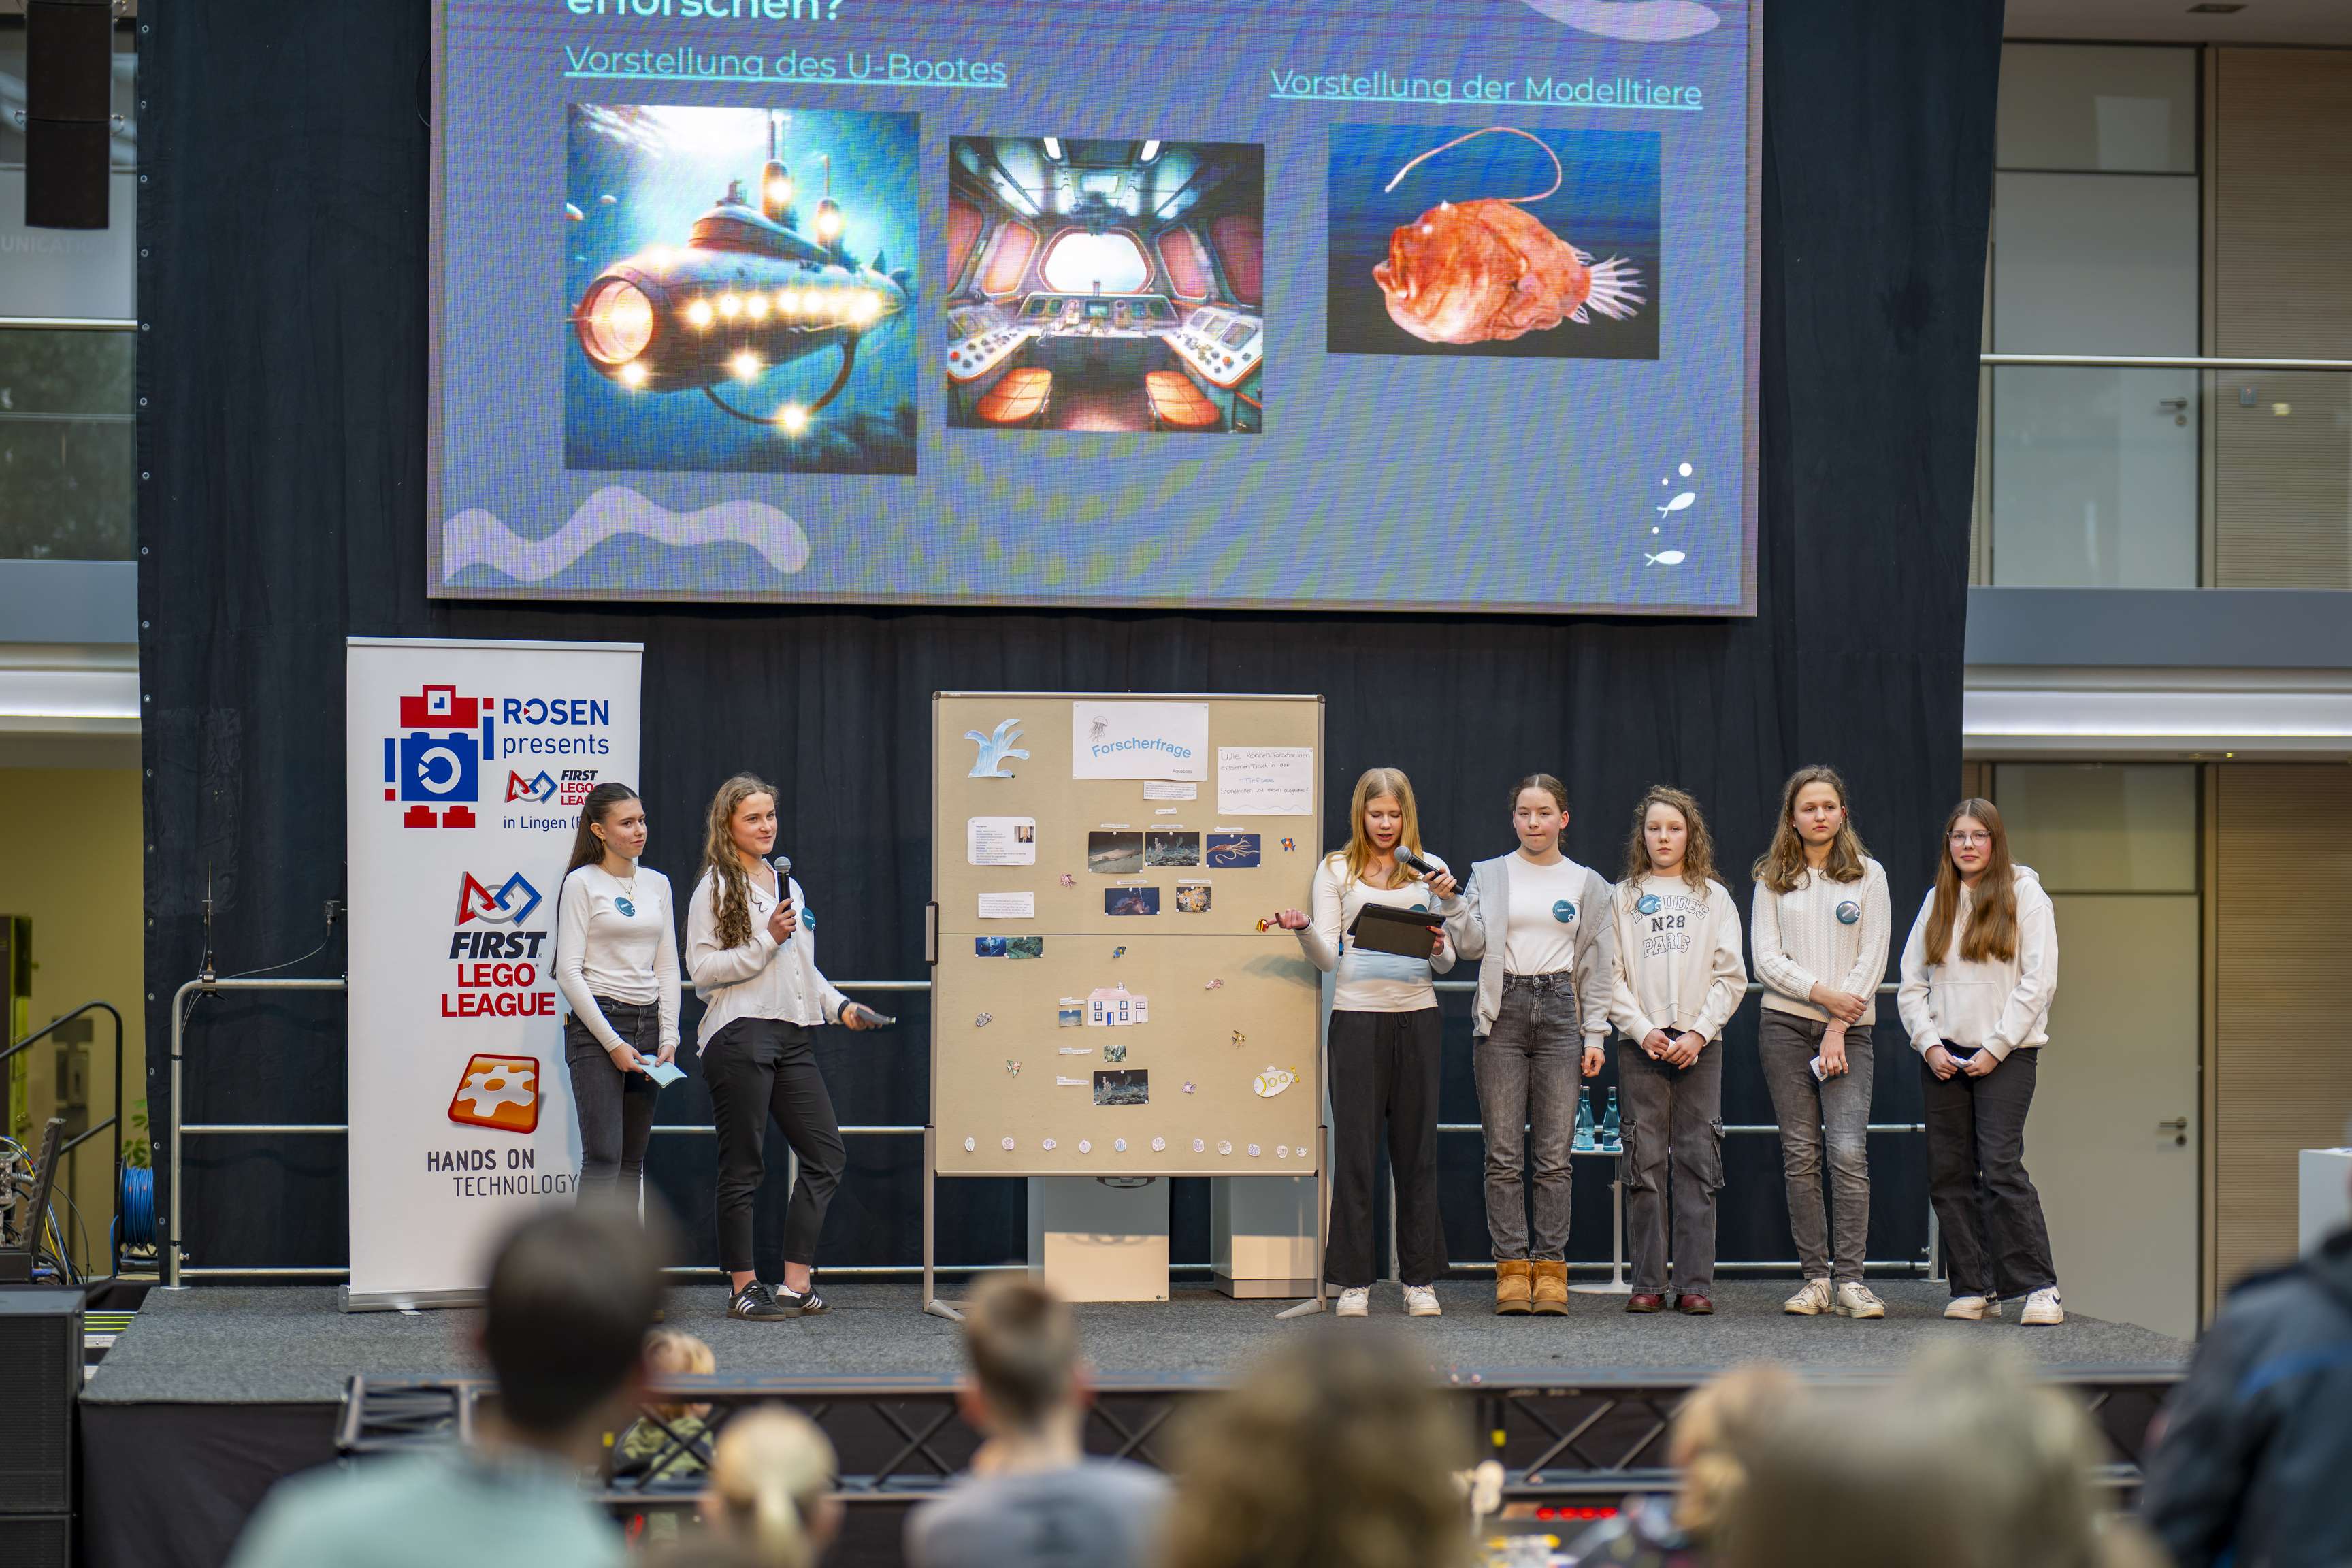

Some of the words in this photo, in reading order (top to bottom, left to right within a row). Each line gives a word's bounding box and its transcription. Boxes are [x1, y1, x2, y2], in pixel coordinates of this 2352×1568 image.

[566, 46, 764, 79] Vorstellung
[776, 50, 836, 78] des
[848, 53, 1007, 82] U-Bootes
[1271, 69, 1451, 103] Vorstellung
[1463, 73, 1514, 100] der
[1526, 76, 1703, 105] Modelltiere
[503, 698, 610, 725] ROSEN
[503, 734, 610, 759] presents
[1091, 737, 1192, 758] Forscherfrage
[561, 770, 598, 781] FIRST
[561, 783, 594, 793] LEGO
[561, 795, 586, 805] LEA
[504, 816, 515, 828] in
[521, 816, 566, 832] Lingen
[449, 932, 547, 959] FIRST
[458, 963, 536, 987] LEGO
[442, 992, 556, 1017] LEAGUE
[427, 1150, 496, 1172] HANDS
[507, 1148, 534, 1170] ON
[453, 1174, 578, 1196] TECHNOLOGY
